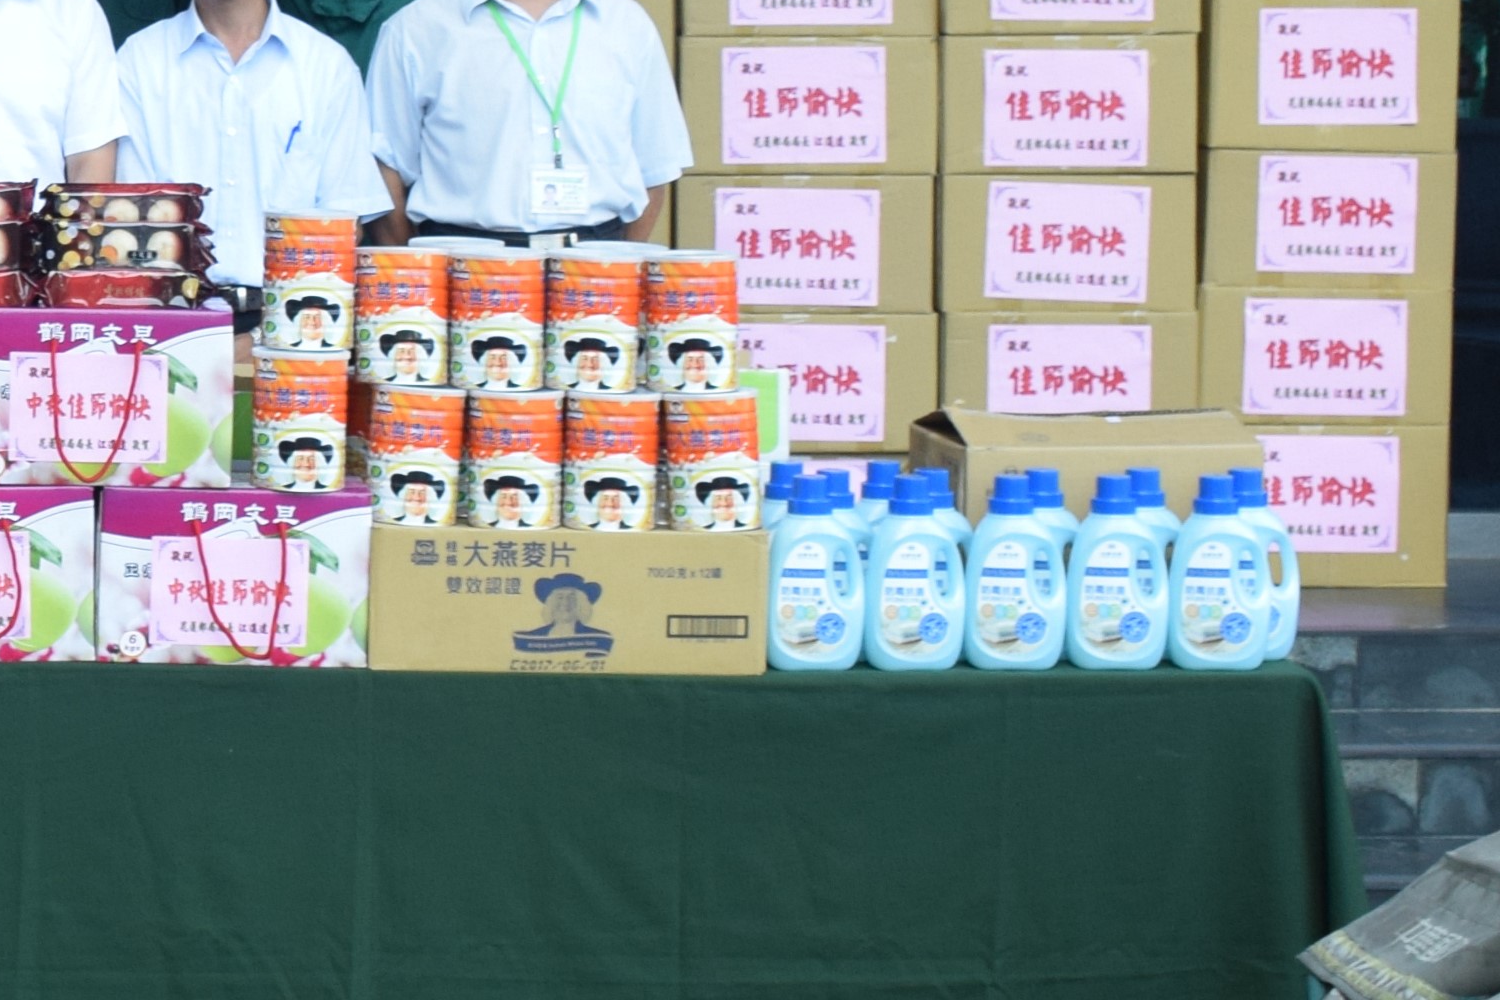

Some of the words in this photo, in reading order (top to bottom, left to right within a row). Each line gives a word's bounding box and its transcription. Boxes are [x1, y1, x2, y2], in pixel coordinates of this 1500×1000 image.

[1279, 48, 1395, 80] 佳節愉快
[742, 86, 863, 119] 佳節愉快
[1005, 90, 1126, 121] 佳節愉快
[1278, 196, 1394, 228] 佳節愉快
[735, 228, 857, 260] 佳節愉快
[1008, 222, 1126, 257] 佳節愉快
[37, 322, 158, 345] 鶴岡文旦
[1265, 339, 1384, 371] 佳節愉快
[788, 364, 863, 397] 愉快
[1009, 364, 1129, 397] 佳節愉快
[26, 392, 152, 421] 中秋佳節愉快
[180, 502, 300, 526] 鶴岡文旦
[464, 540, 577, 569] 大燕麥片
[168, 577, 293, 607] 中秋佳節愉快
[445, 576, 523, 596] 雙效認證
[128, 633, 138, 645] 6
